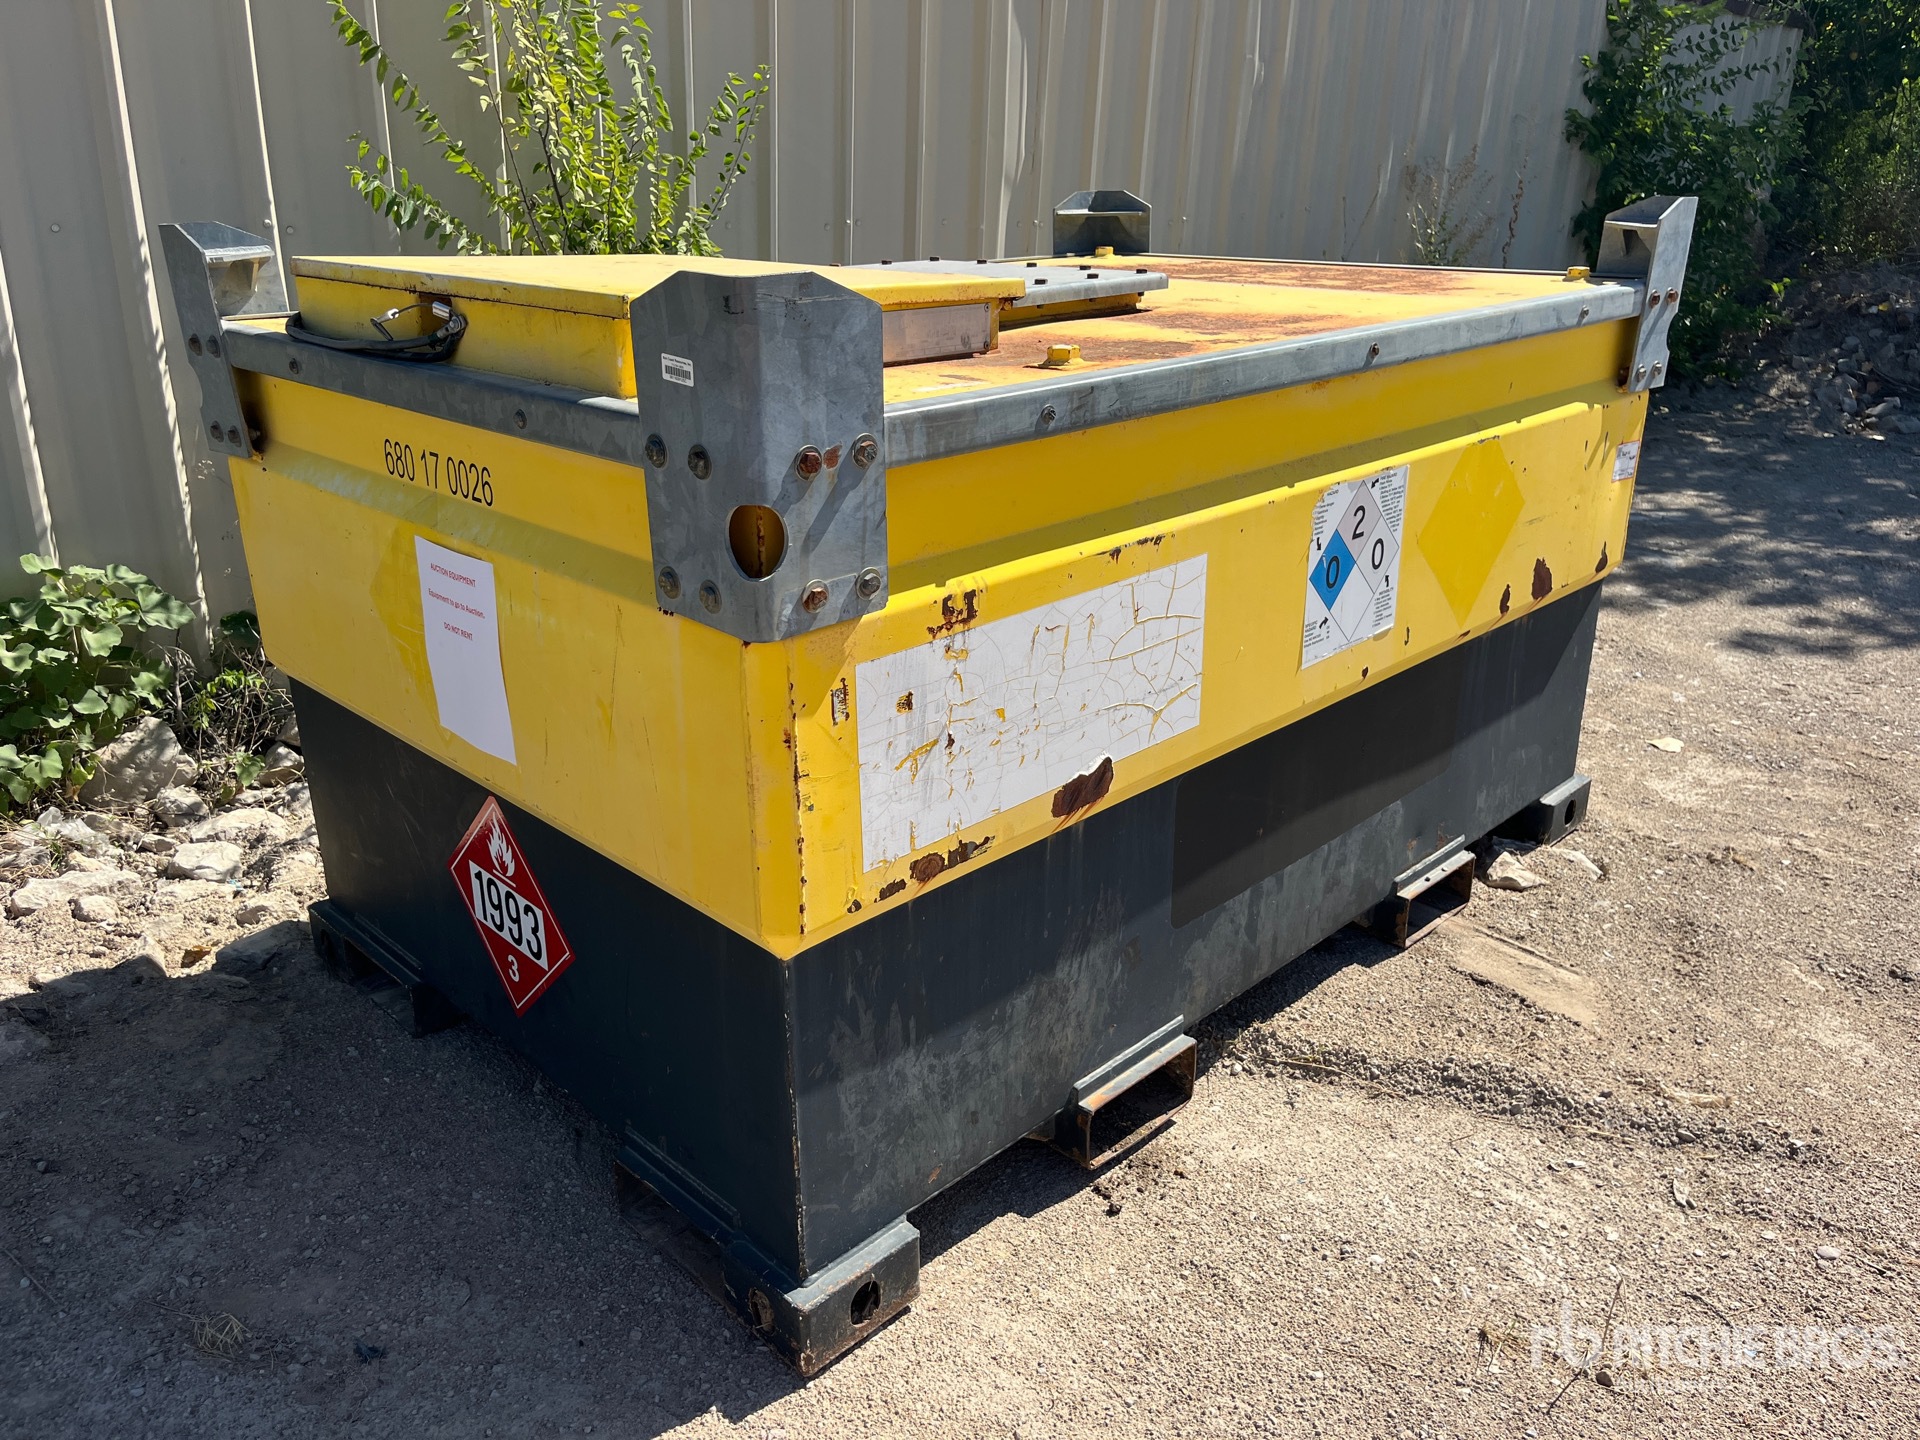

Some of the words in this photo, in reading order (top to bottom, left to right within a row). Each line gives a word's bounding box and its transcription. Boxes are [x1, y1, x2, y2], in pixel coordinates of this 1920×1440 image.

[384, 438, 415, 482] 680
[420, 449, 439, 489] 17
[446, 456, 494, 507] 0026
[1351, 504, 1366, 541] 2
[1371, 537, 1385, 570] 0
[430, 562, 449, 577] AUCTION
[448, 570, 476, 588] EQUIPMENT
[1325, 555, 1340, 590] 0
[428, 587, 450, 604] Equipment
[449, 598, 455, 606] to
[454, 601, 460, 609] go
[459, 603, 466, 611] to
[443, 621, 451, 631] DO
[450, 625, 460, 635] NOT
[460, 629, 473, 641] RENT
[474, 870, 543, 962] 1993
[507, 954, 520, 983] 3
